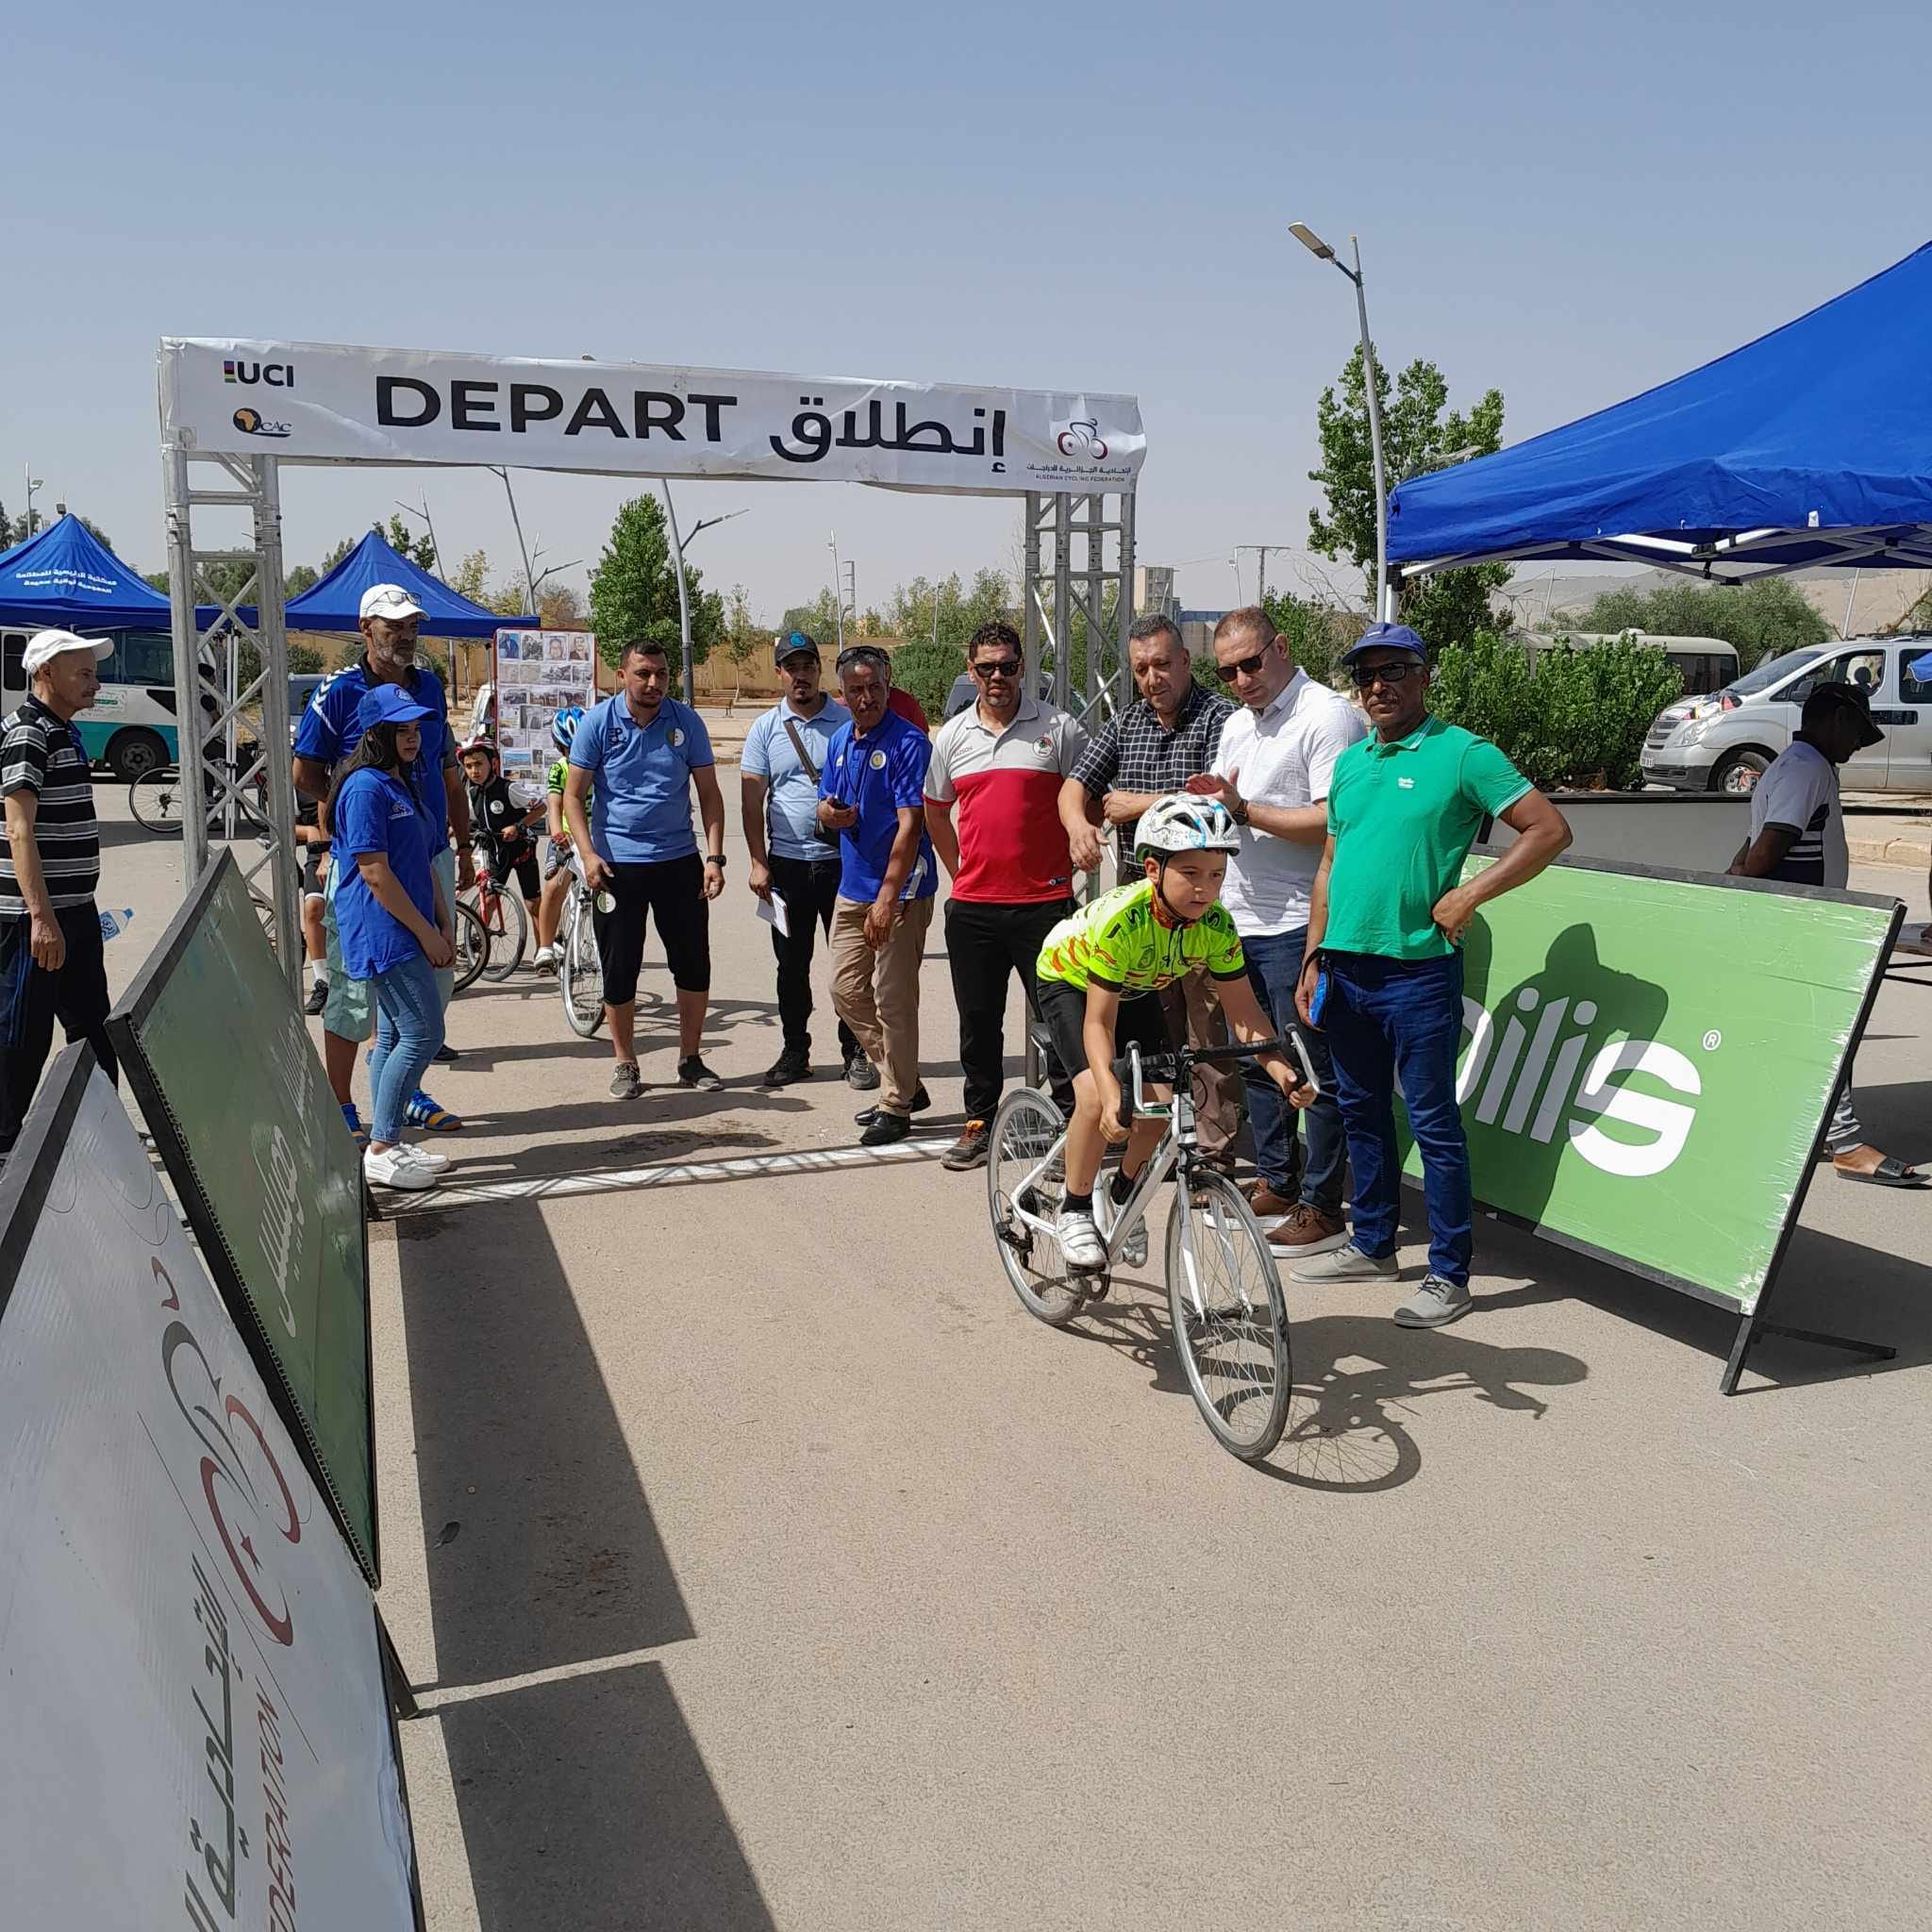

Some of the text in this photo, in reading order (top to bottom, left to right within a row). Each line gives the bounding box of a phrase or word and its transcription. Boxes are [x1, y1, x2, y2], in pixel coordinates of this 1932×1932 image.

[236, 360, 294, 388] UCI
[376, 375, 738, 442] DEPART
[769, 396, 1006, 474] إنطلاق
[255, 1675, 297, 1932] DERATION
